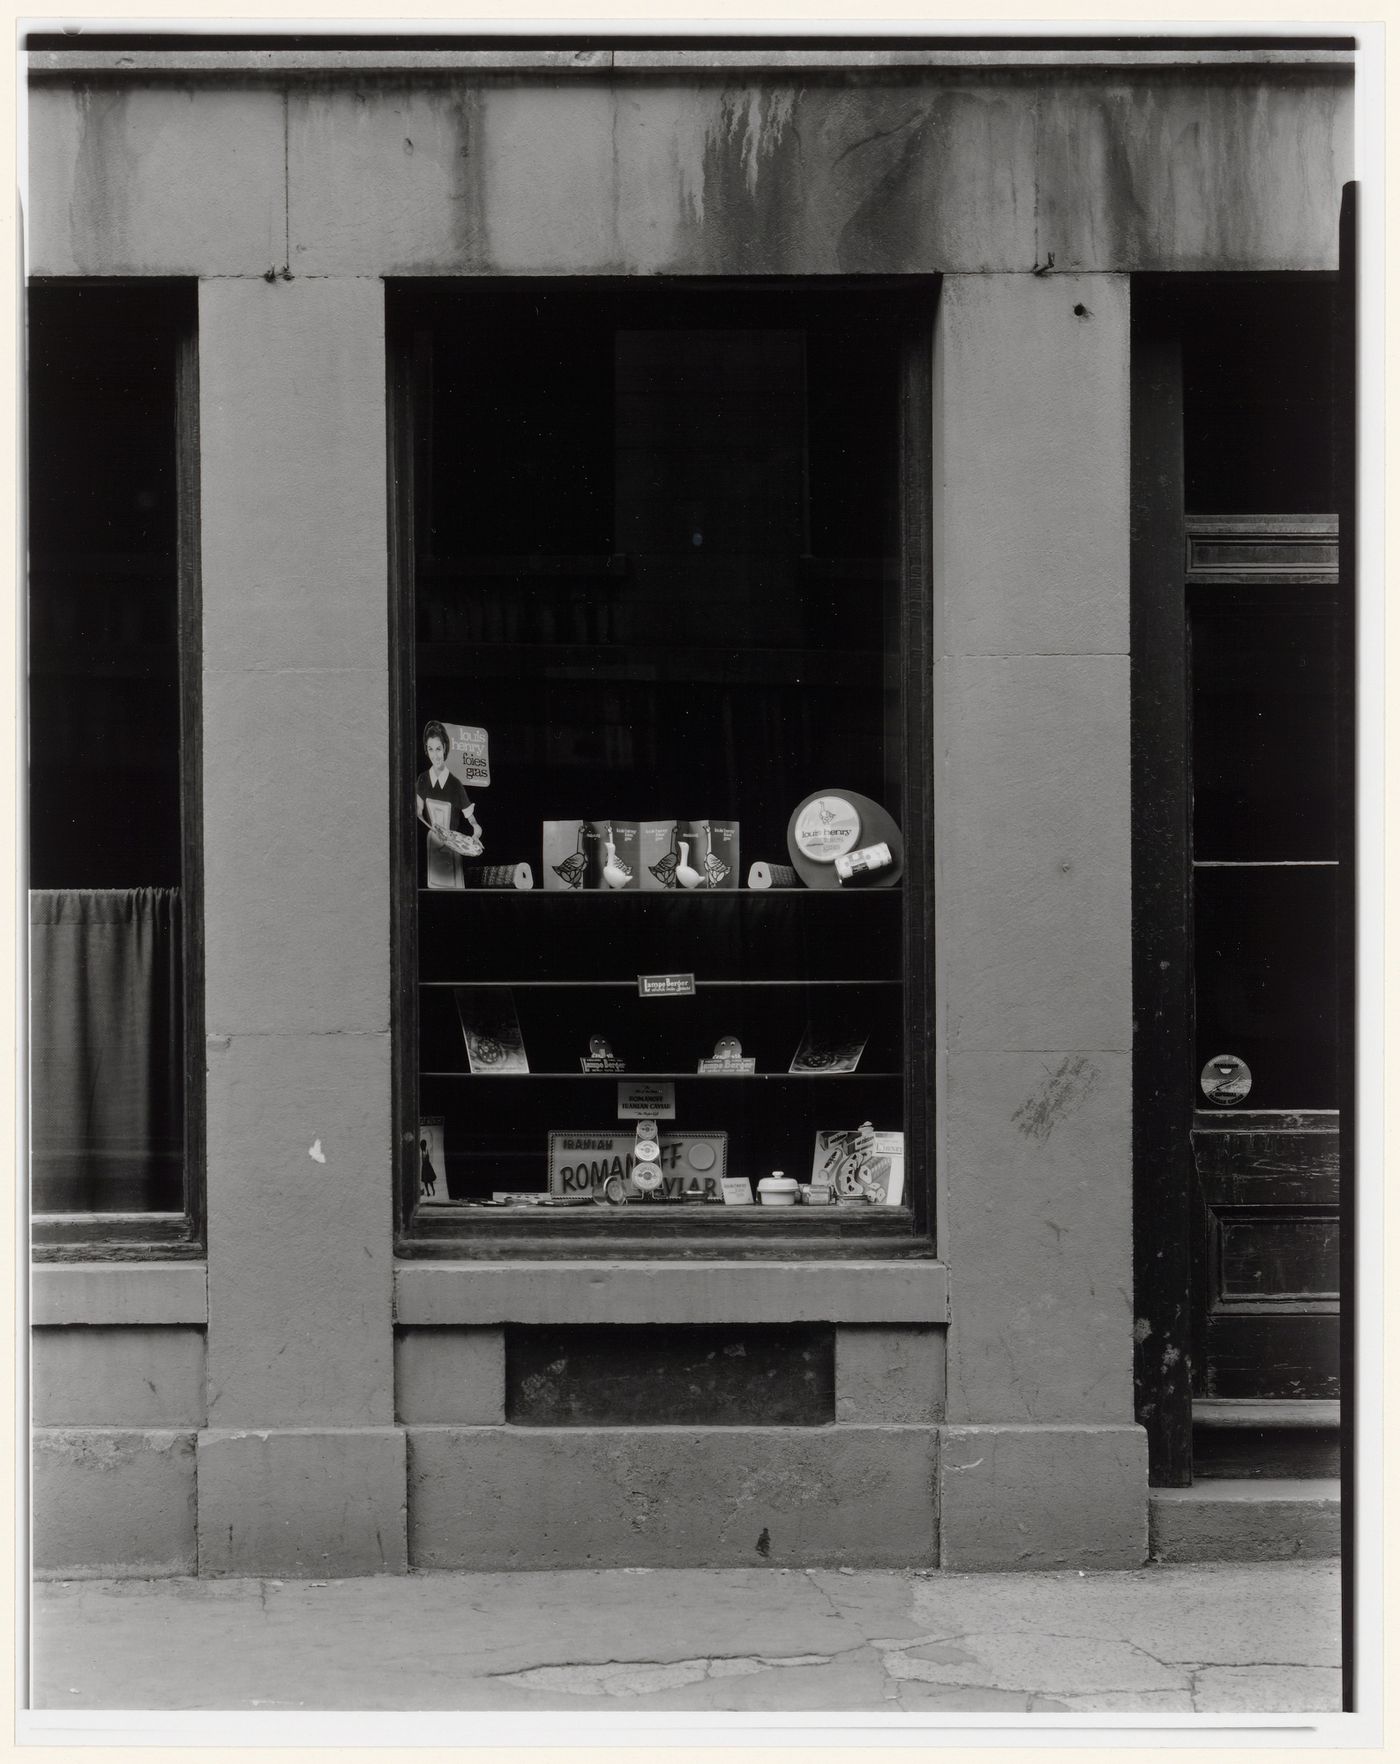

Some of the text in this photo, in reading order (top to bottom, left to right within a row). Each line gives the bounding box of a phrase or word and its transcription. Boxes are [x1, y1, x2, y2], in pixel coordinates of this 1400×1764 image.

[460, 728, 486, 741] louis
[451, 737, 485, 756] henry
[463, 752, 487, 767] foies
[823, 828, 852, 837] henry
[643, 978, 666, 993] Lampe
[665, 977, 690, 992] Berger
[562, 1138, 614, 1151] IRANIAN
[560, 1142, 683, 1194] ROMANFF
